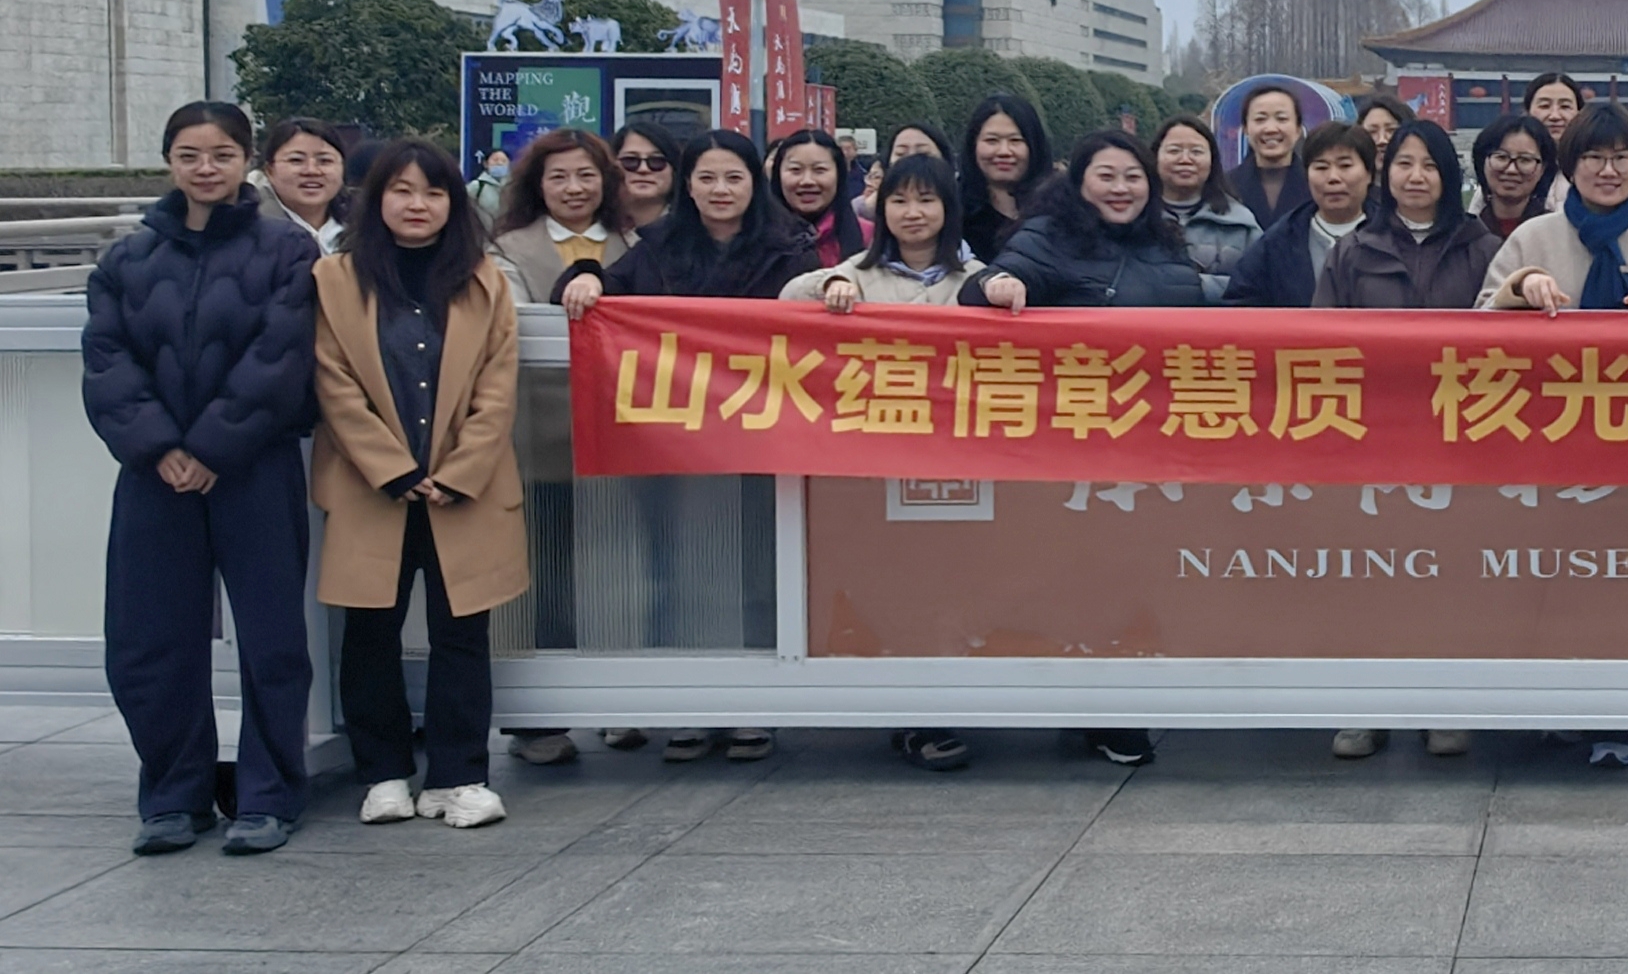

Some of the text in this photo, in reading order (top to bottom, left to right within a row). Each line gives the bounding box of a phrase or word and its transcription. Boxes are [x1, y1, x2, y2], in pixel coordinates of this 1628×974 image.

[479, 71, 554, 85] MAPPING
[478, 87, 512, 101] THE
[478, 103, 539, 117] WORLD
[614, 332, 1368, 441] 山水蕴情彰慧质
[1177, 548, 1439, 578] NANJING
